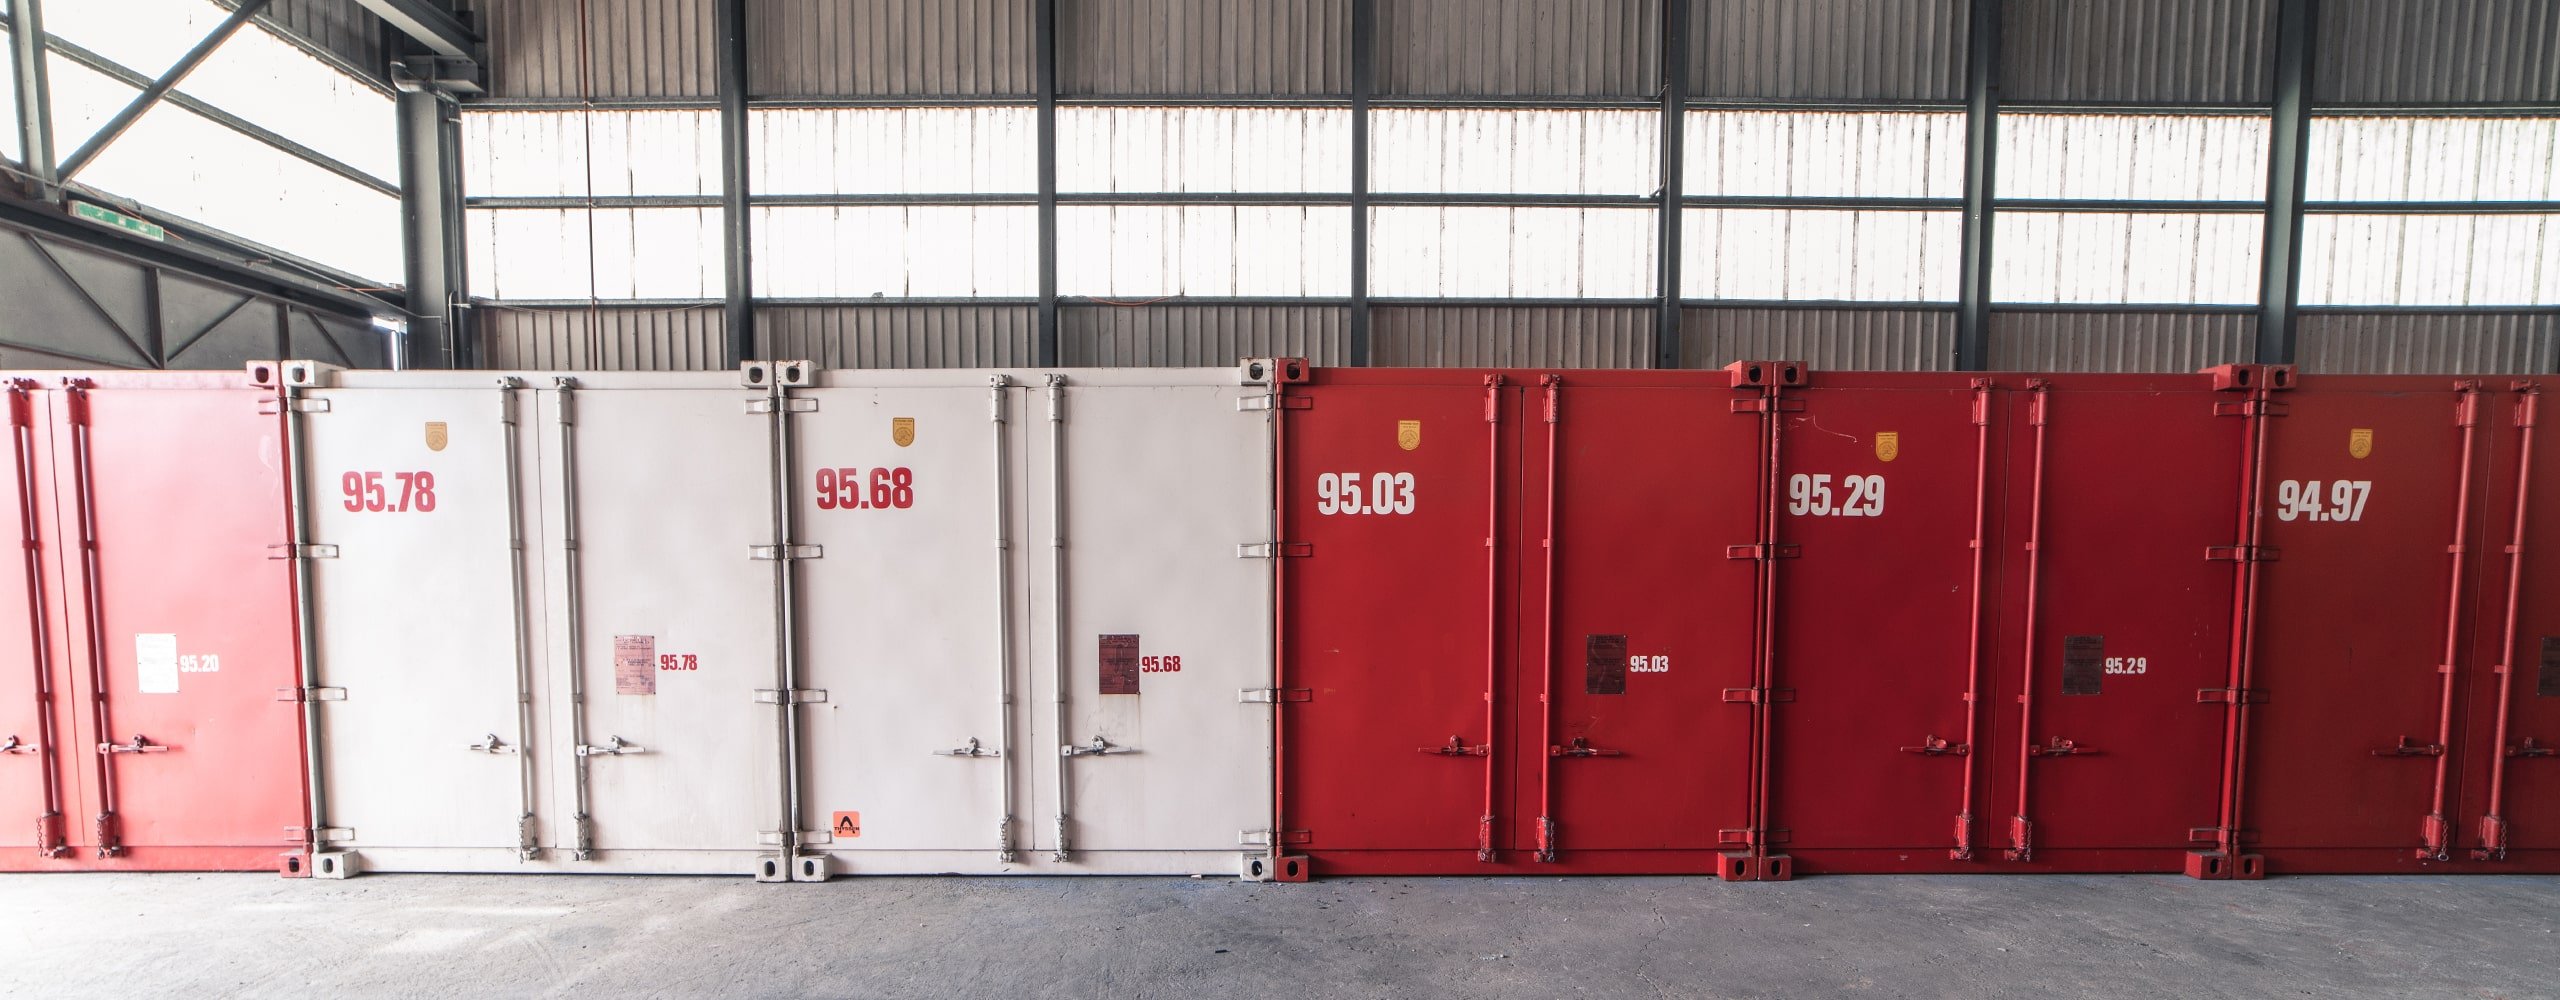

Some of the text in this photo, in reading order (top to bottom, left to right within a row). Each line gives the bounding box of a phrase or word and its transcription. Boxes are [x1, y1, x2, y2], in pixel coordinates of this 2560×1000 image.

[343, 471, 436, 512] 95.78
[816, 467, 913, 510] 95.68
[1318, 472, 1415, 515] 95.03
[1789, 474, 1885, 517] 95.29
[2278, 480, 2371, 522] 94.97
[180, 654, 220, 673] 95.20
[660, 654, 698, 671] 95.78
[1141, 655, 1181, 673] 95.68
[1630, 655, 1669, 673] 95.03
[2105, 657, 2147, 675] 95.29
